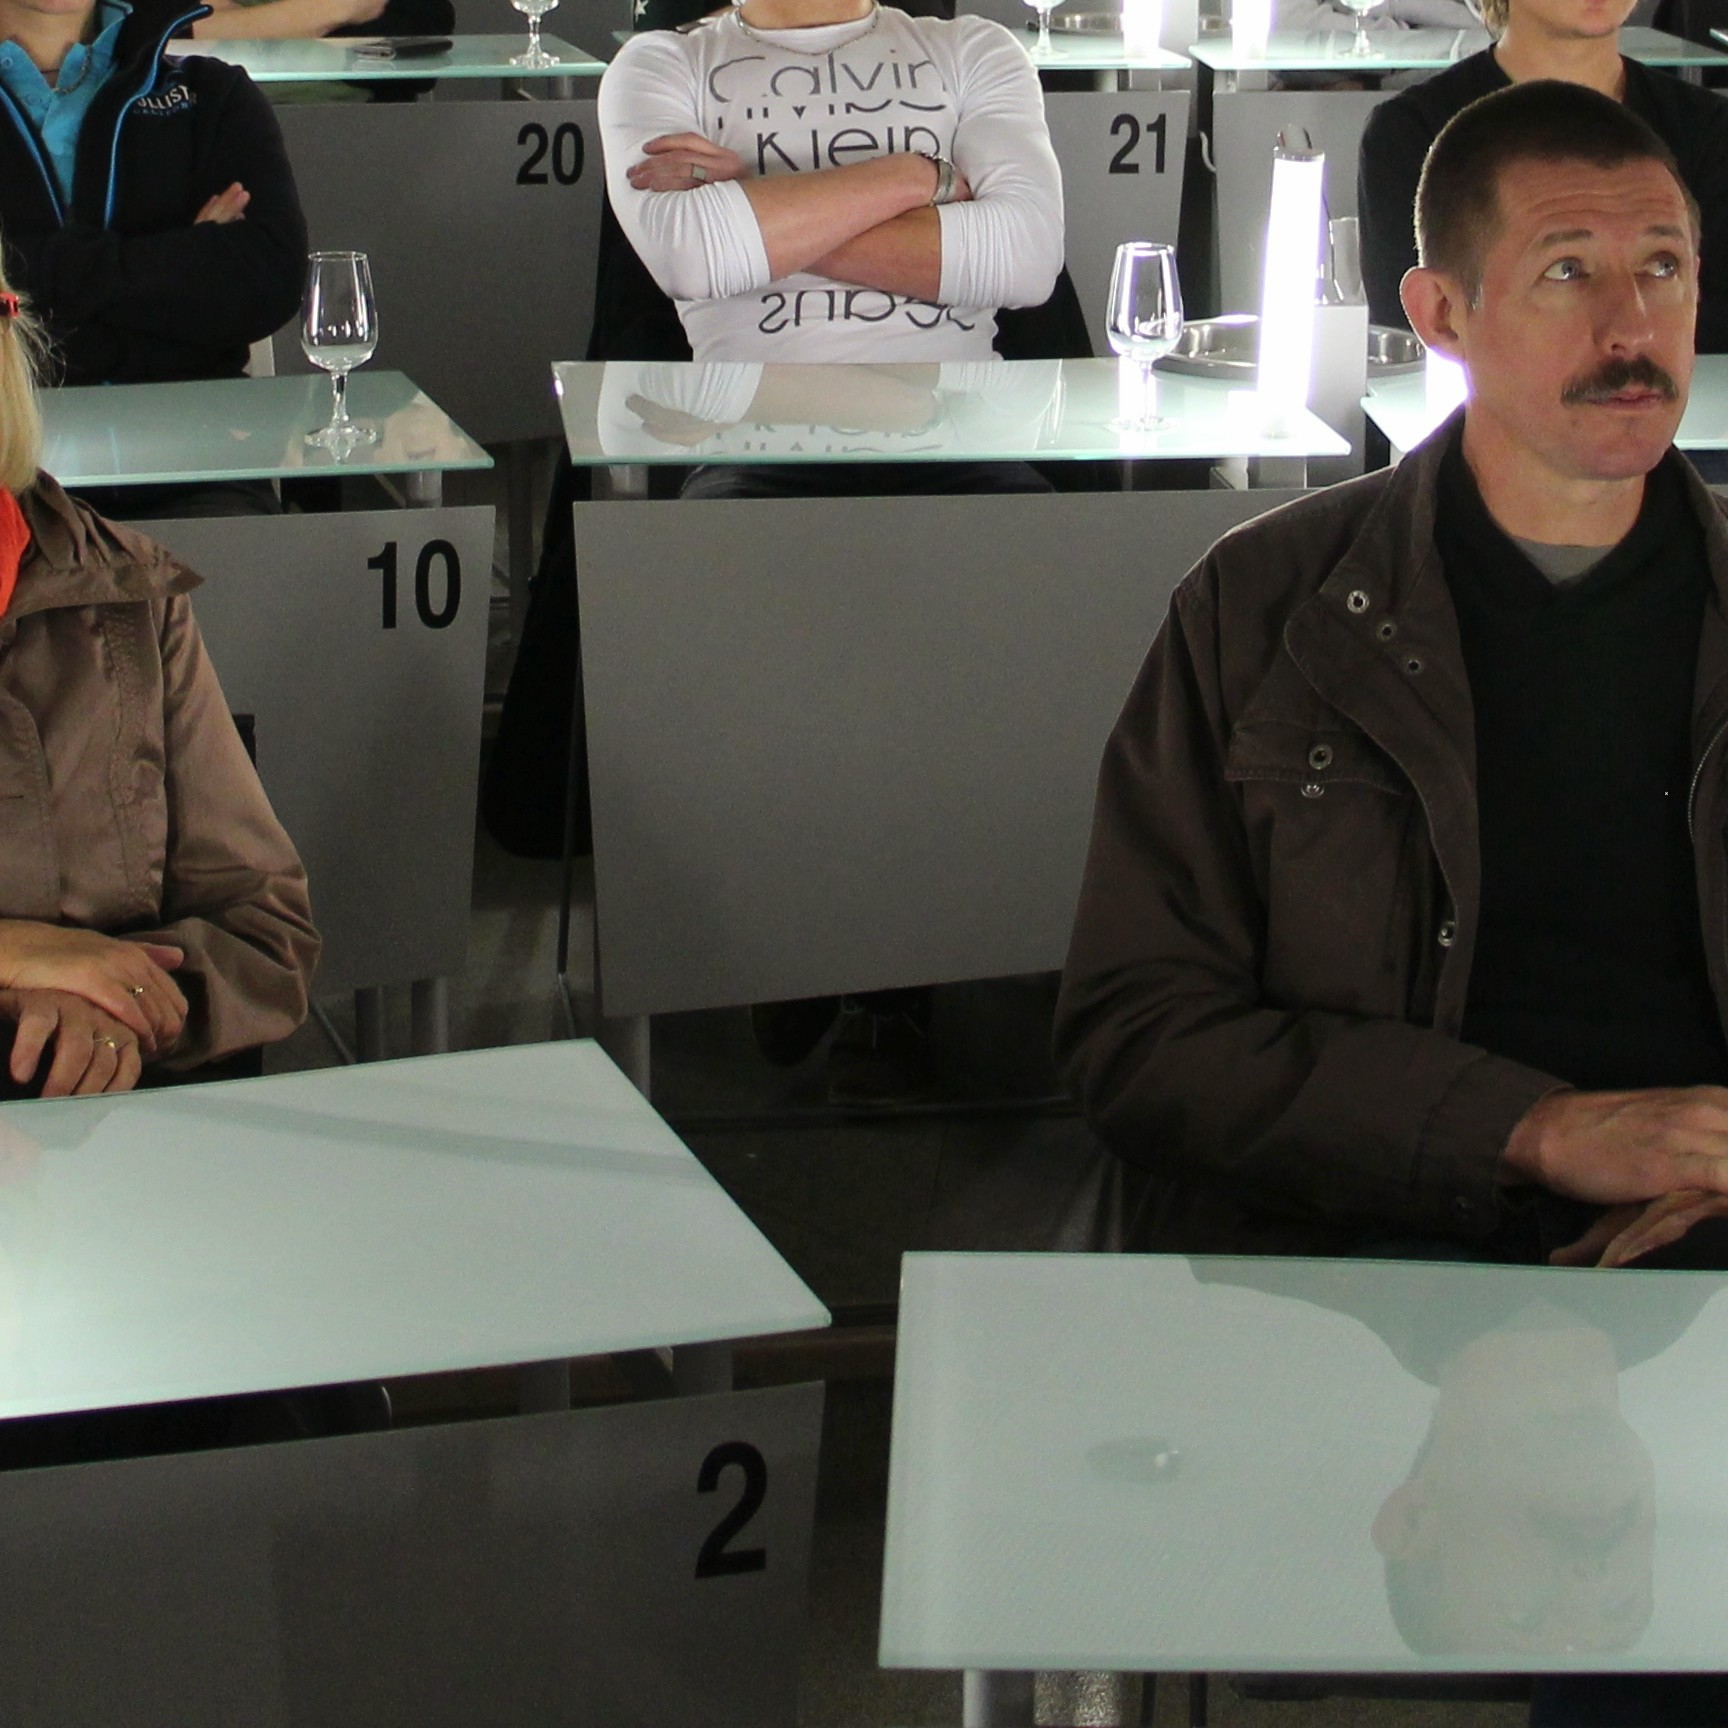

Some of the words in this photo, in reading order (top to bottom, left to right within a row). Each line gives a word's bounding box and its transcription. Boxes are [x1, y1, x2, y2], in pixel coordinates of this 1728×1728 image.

[709, 50, 946, 103] Calvin
[516, 122, 585, 186] 20
[1108, 113, 1167, 175] 21
[367, 539, 462, 630] 10
[694, 1440, 769, 1579] 2
